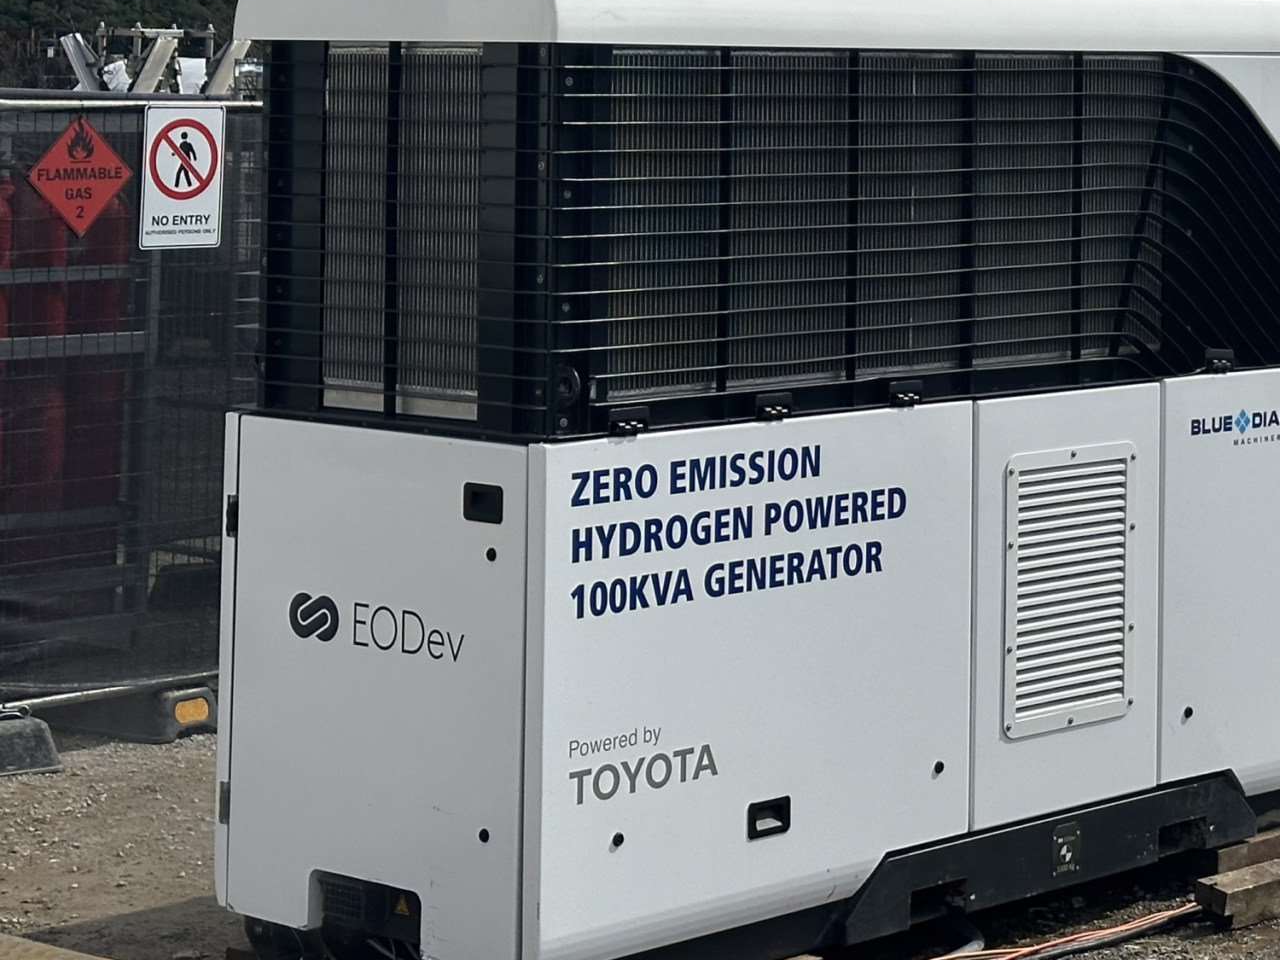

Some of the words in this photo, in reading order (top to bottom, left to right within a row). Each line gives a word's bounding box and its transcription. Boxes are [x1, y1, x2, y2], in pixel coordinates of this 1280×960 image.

[37, 167, 123, 181] FLAMMABLE
[65, 187, 92, 200] GAS
[75, 205, 84, 219] 2
[151, 215, 169, 226] NO
[172, 214, 211, 226] ENTRY
[1190, 415, 1233, 436] BLUE
[571, 464, 658, 507] ZERO
[669, 444, 821, 495] EMISSION
[571, 505, 753, 564] HYDROGEN
[764, 486, 907, 536] POWERED
[570, 568, 694, 619] 100KVA
[704, 540, 883, 598] GENERATOR
[353, 602, 465, 663] EODev
[569, 728, 637, 758] Powered
[643, 726, 661, 746] by
[569, 744, 718, 805] TOYOTA
